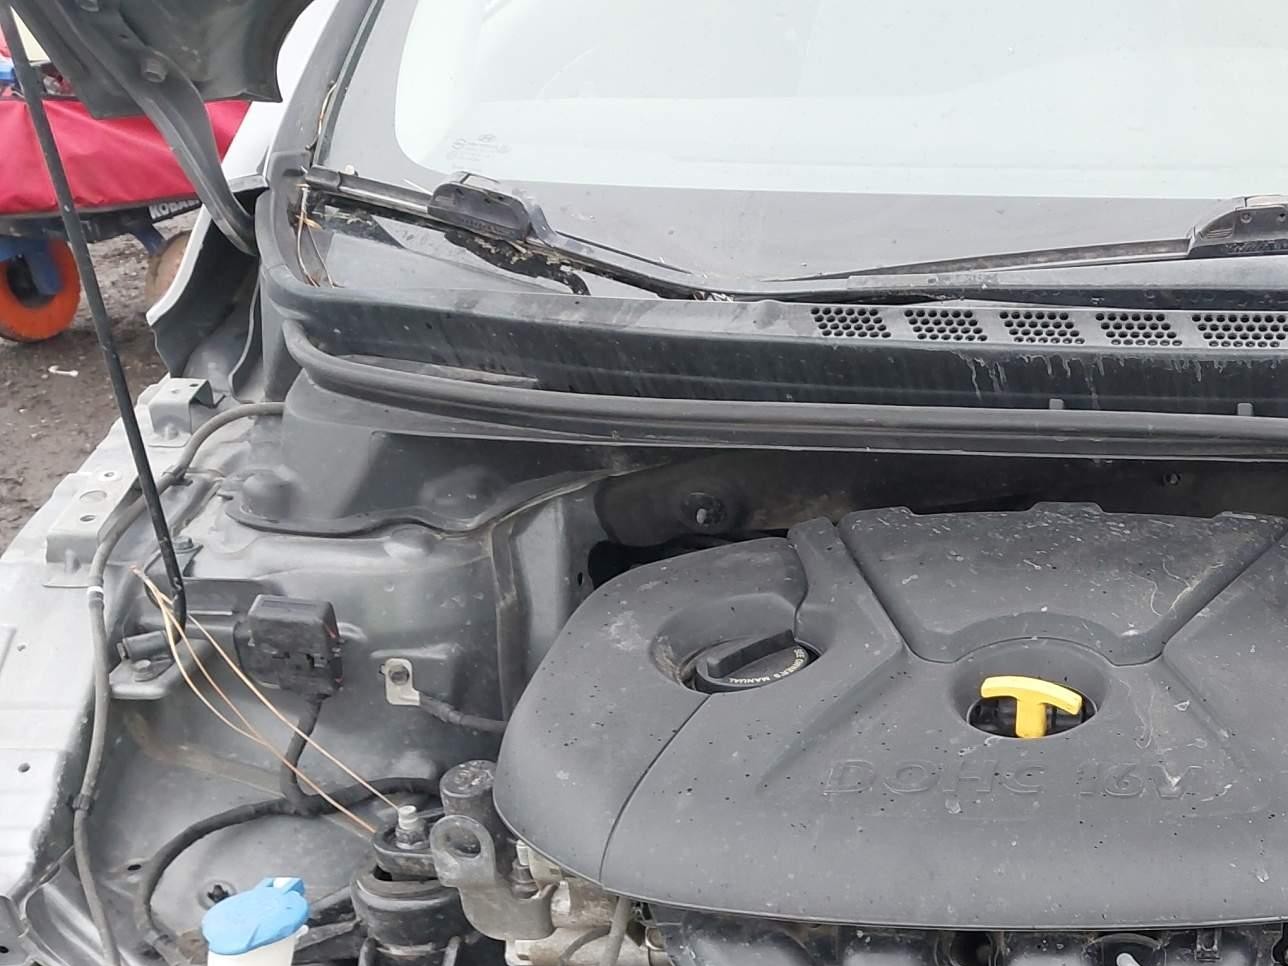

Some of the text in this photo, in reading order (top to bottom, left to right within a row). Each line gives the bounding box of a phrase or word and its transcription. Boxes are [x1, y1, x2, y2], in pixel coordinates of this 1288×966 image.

[729, 676, 770, 684] MANUAL
[823, 758, 1203, 799] DOHC 16V
